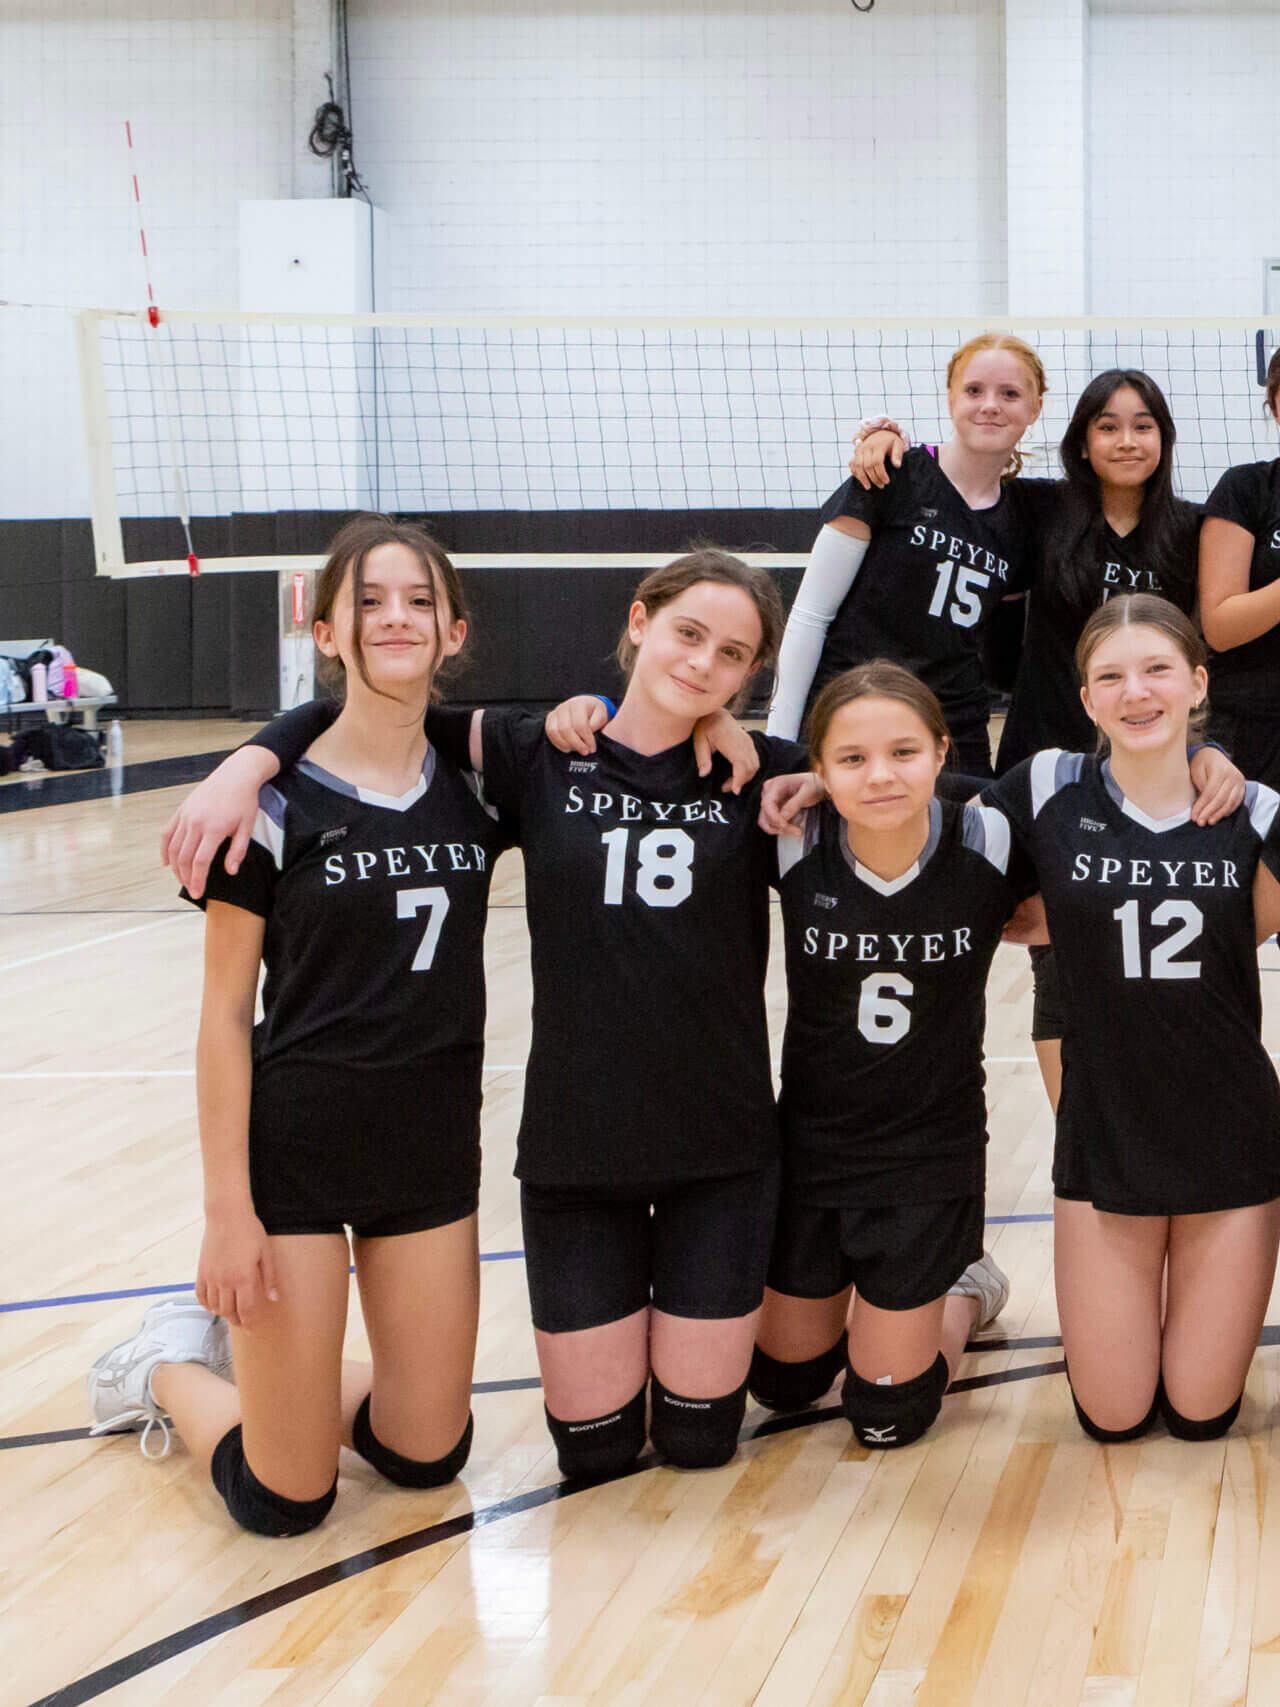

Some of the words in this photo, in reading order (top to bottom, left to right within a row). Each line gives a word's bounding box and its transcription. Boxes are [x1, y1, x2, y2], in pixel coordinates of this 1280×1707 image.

[910, 524, 1010, 583] SPEYER
[928, 559, 991, 628] 15
[564, 785, 730, 825] SPEYER
[324, 843, 486, 886] SPEYER
[601, 827, 695, 907] 18
[1071, 853, 1240, 888] SPEYER
[396, 886, 451, 972] 7
[803, 926, 972, 962] SPEYER
[1113, 899, 1204, 980] 12
[857, 972, 914, 1045] 6
